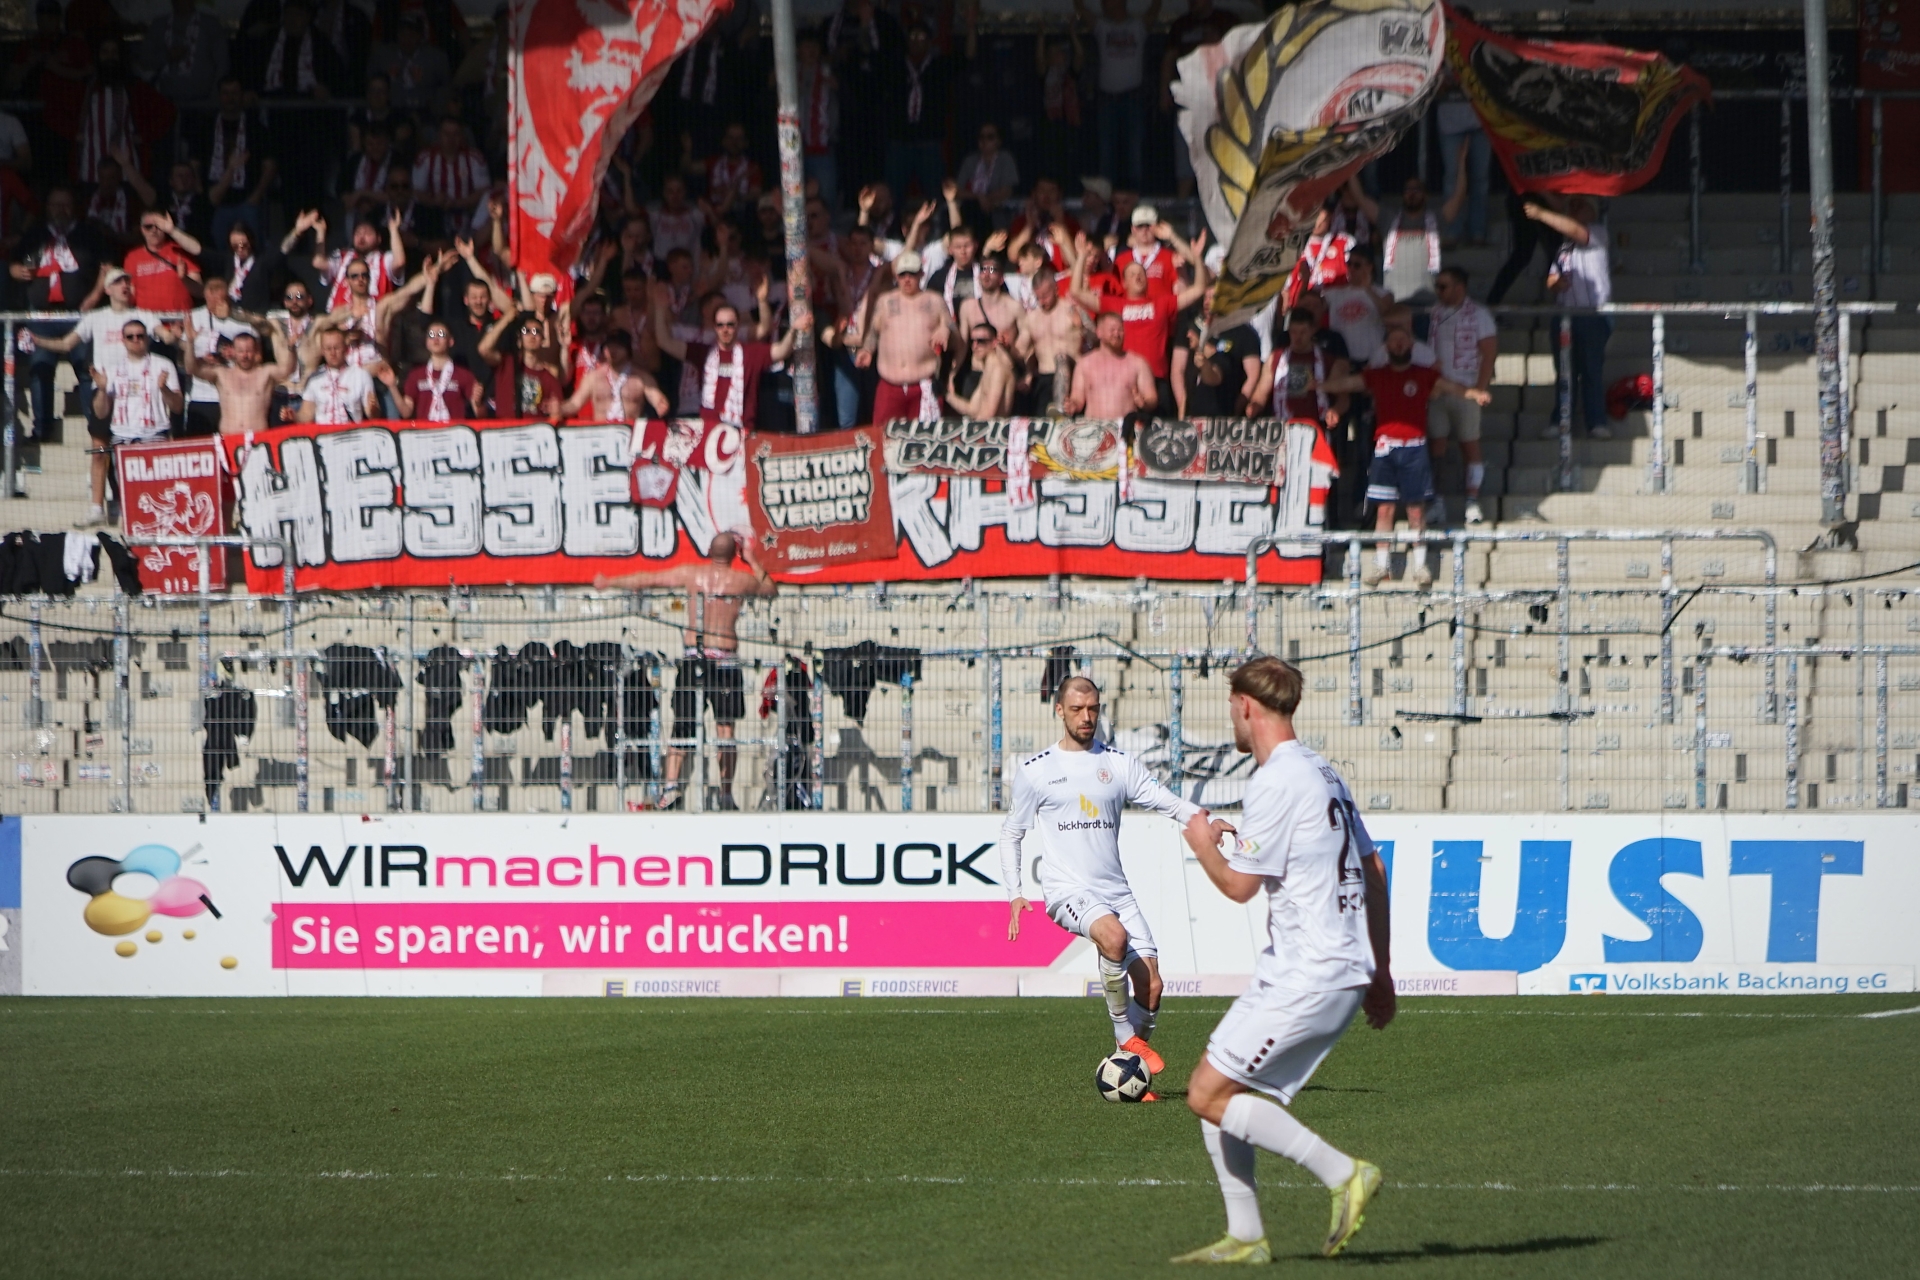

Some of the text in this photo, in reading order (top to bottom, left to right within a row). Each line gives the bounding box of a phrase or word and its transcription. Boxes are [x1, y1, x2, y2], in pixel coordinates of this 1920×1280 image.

[1201, 419, 1283, 446] JUGEND
[762, 449, 867, 482] SEKTION
[1204, 447, 1275, 480] BANDE
[762, 472, 871, 506] STADION
[766, 496, 871, 529] VERBOT
[1057, 819, 1102, 832] bickhardt
[273, 842, 1000, 889] WIRmachenDRUCK
[1374, 838, 1865, 975] UST
[291, 913, 849, 964] Sie sparen, wir drucken!
[633, 980, 722, 994] FOODSERVICE
[871, 980, 959, 994] FOODSERVICE
[1612, 972, 1888, 993] Volksbank Backnang eG
